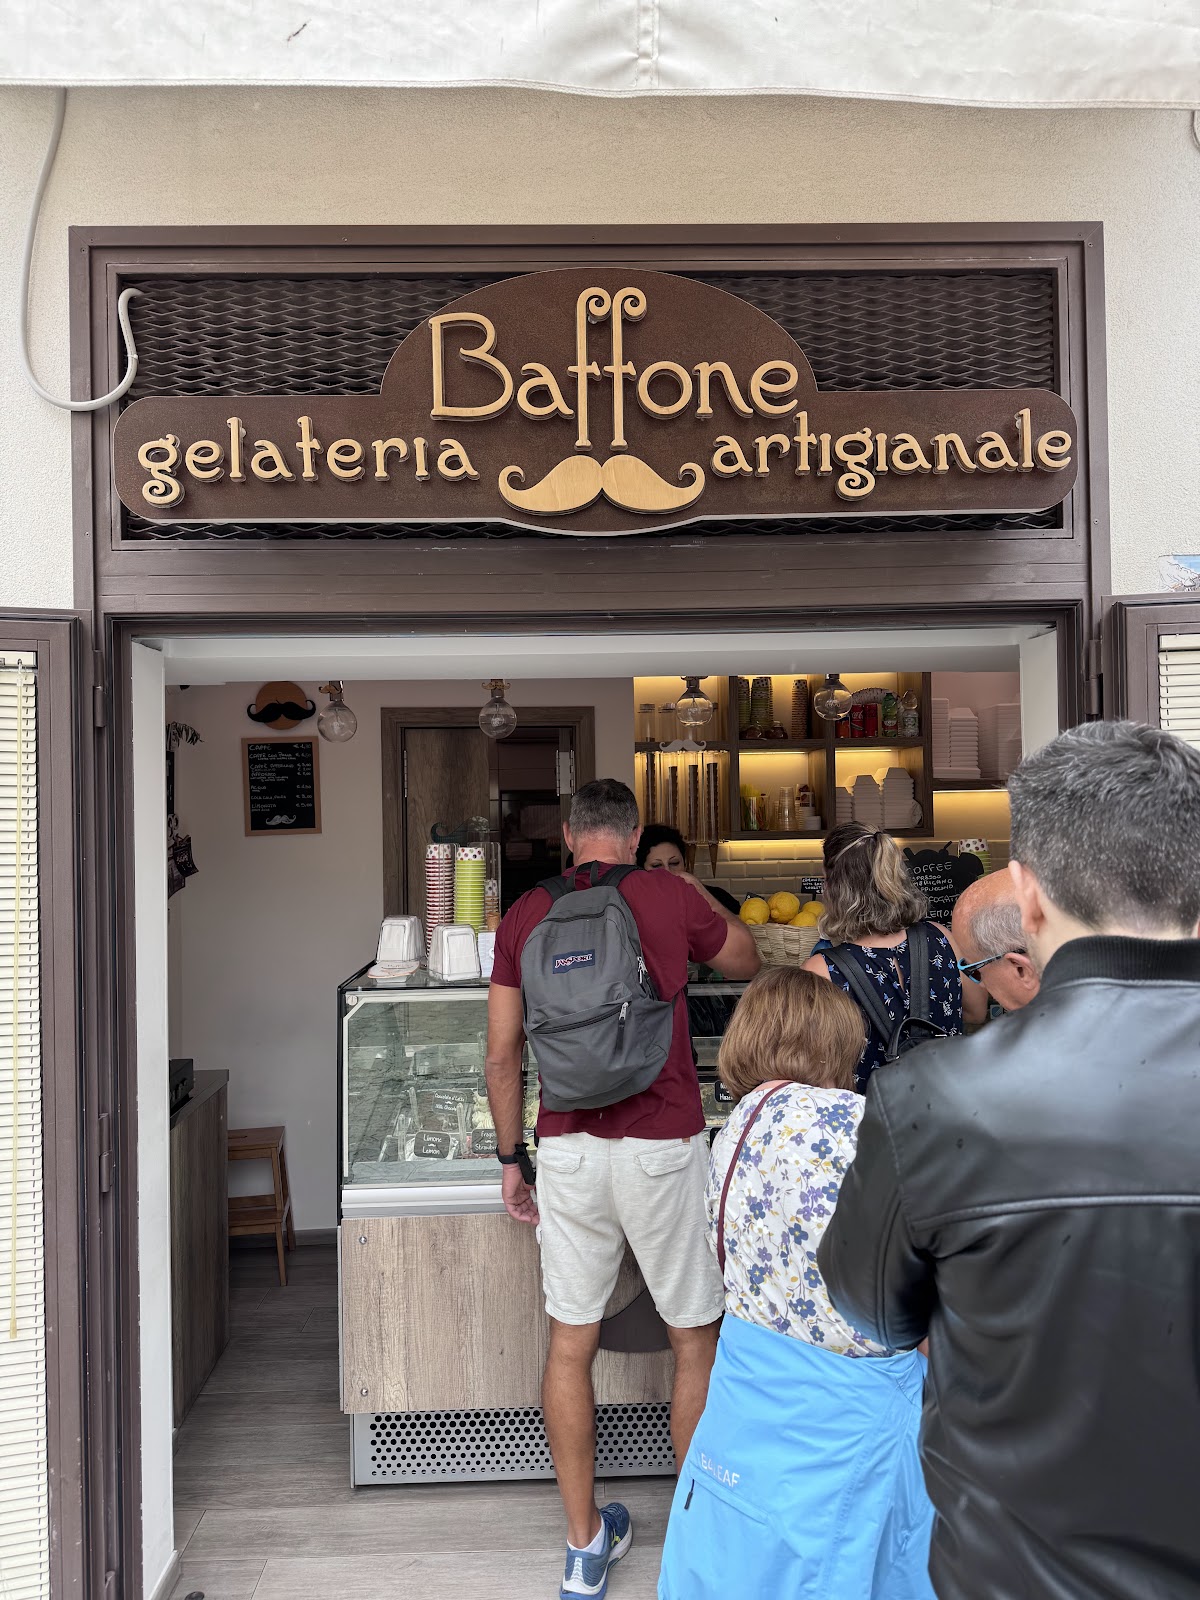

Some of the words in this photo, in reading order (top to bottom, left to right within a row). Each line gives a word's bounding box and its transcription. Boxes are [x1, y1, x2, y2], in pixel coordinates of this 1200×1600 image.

[428, 286, 799, 449] Baffone
[137, 416, 480, 508] gelateria
[711, 407, 1073, 500] artigianale
[913, 879, 953, 887] MERICANO
[924, 909, 953, 919] LEMO
[423, 1133, 442, 1143] Limone
[422, 1145, 441, 1155] Lemon
